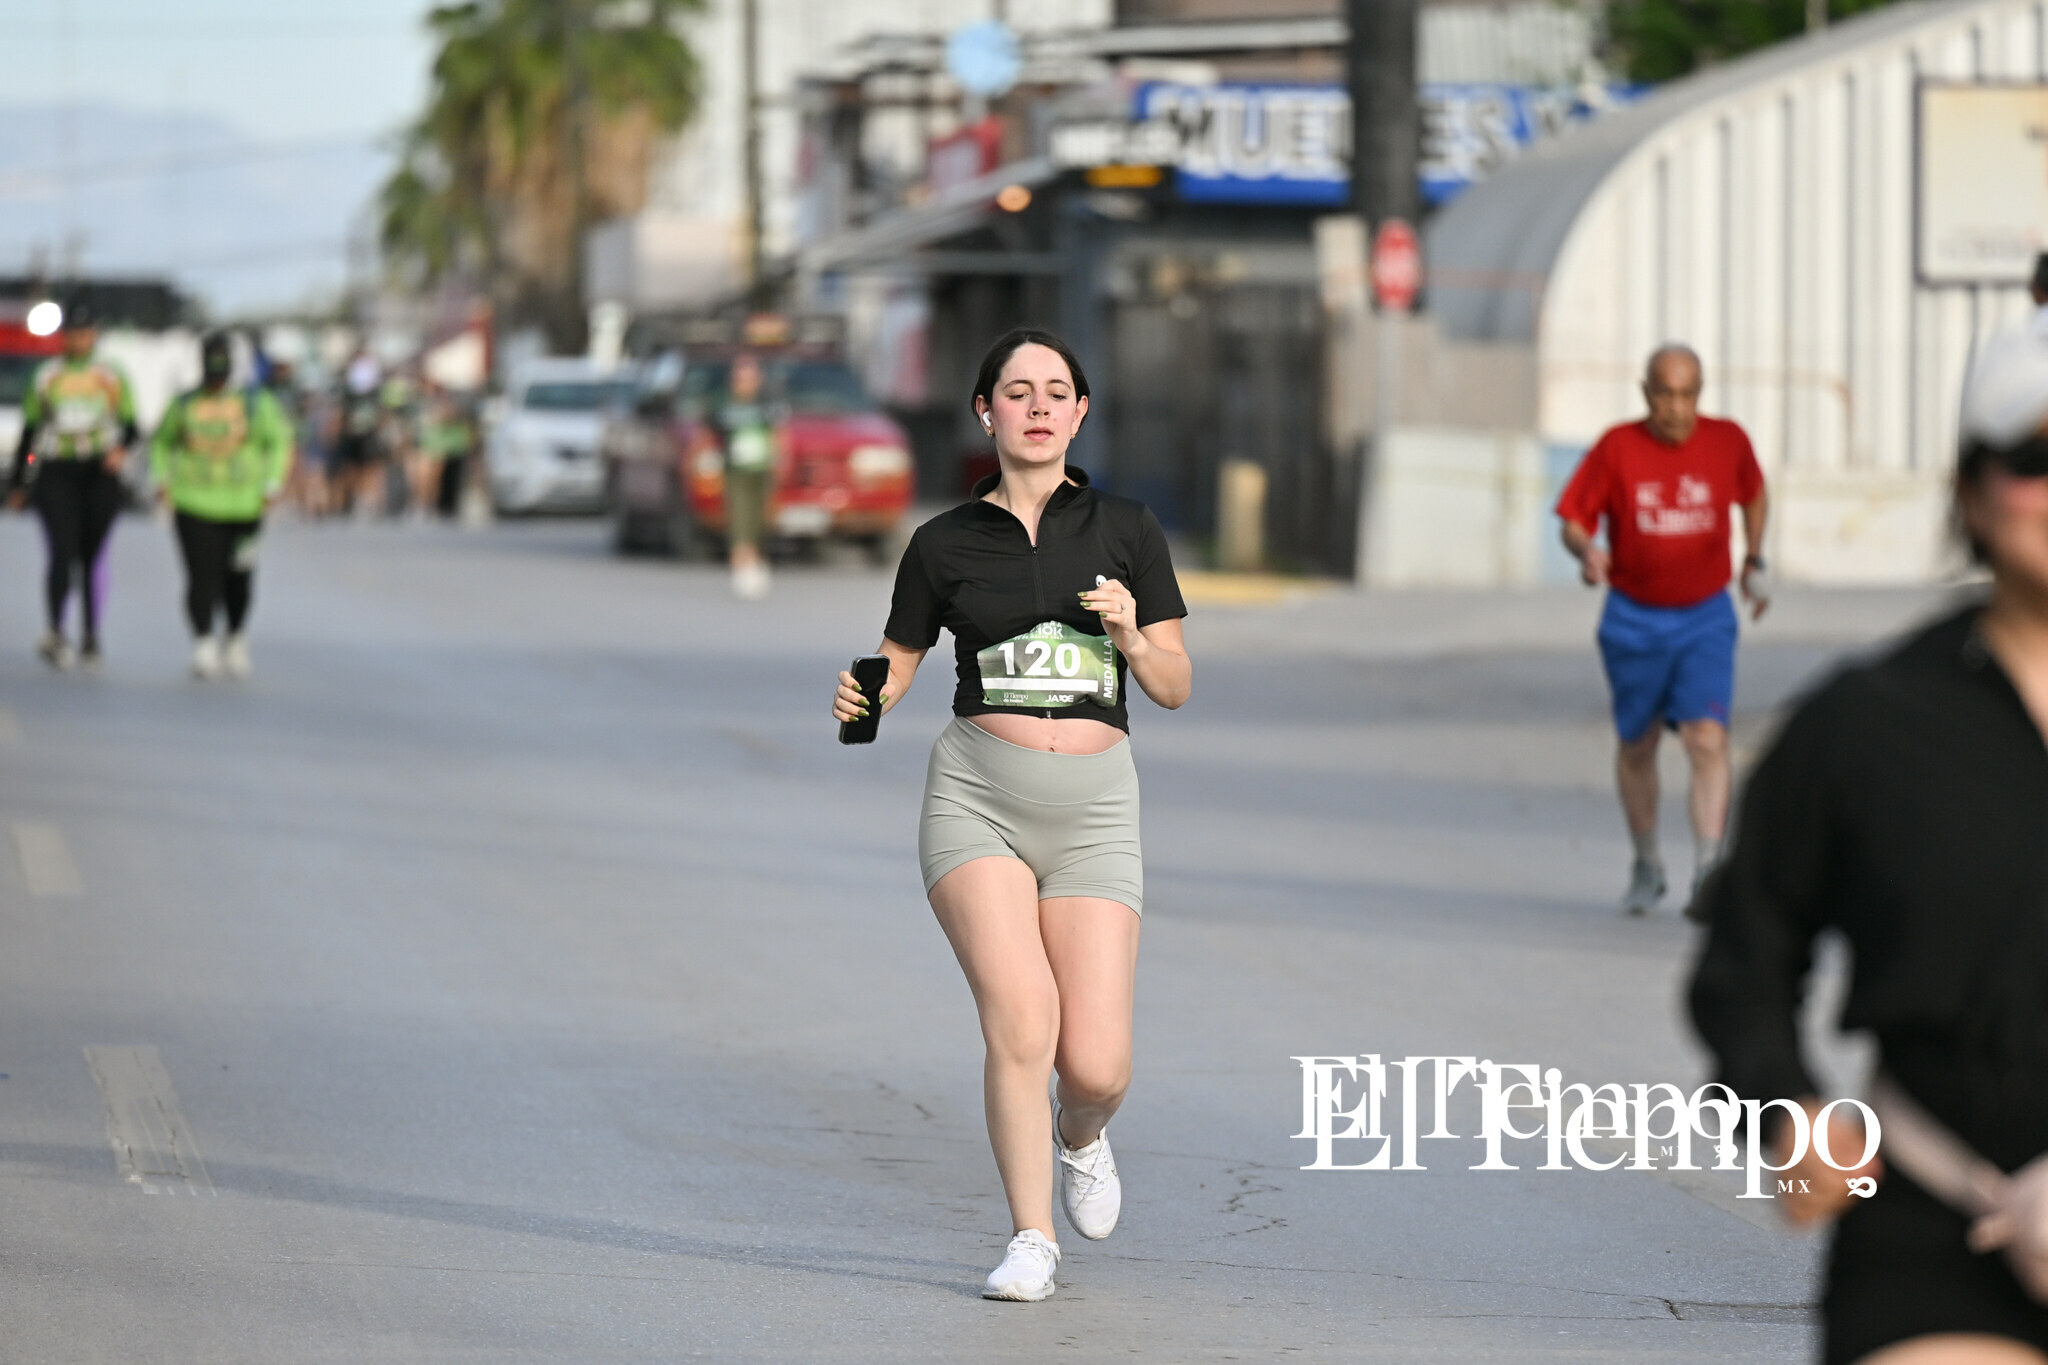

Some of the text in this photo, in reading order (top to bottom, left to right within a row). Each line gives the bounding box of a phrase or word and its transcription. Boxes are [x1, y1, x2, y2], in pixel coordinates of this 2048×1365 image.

[1148, 86, 1510, 180] MUEES
[998, 641, 1081, 677] 120
[1103, 640, 1114, 698] MEDALLA
